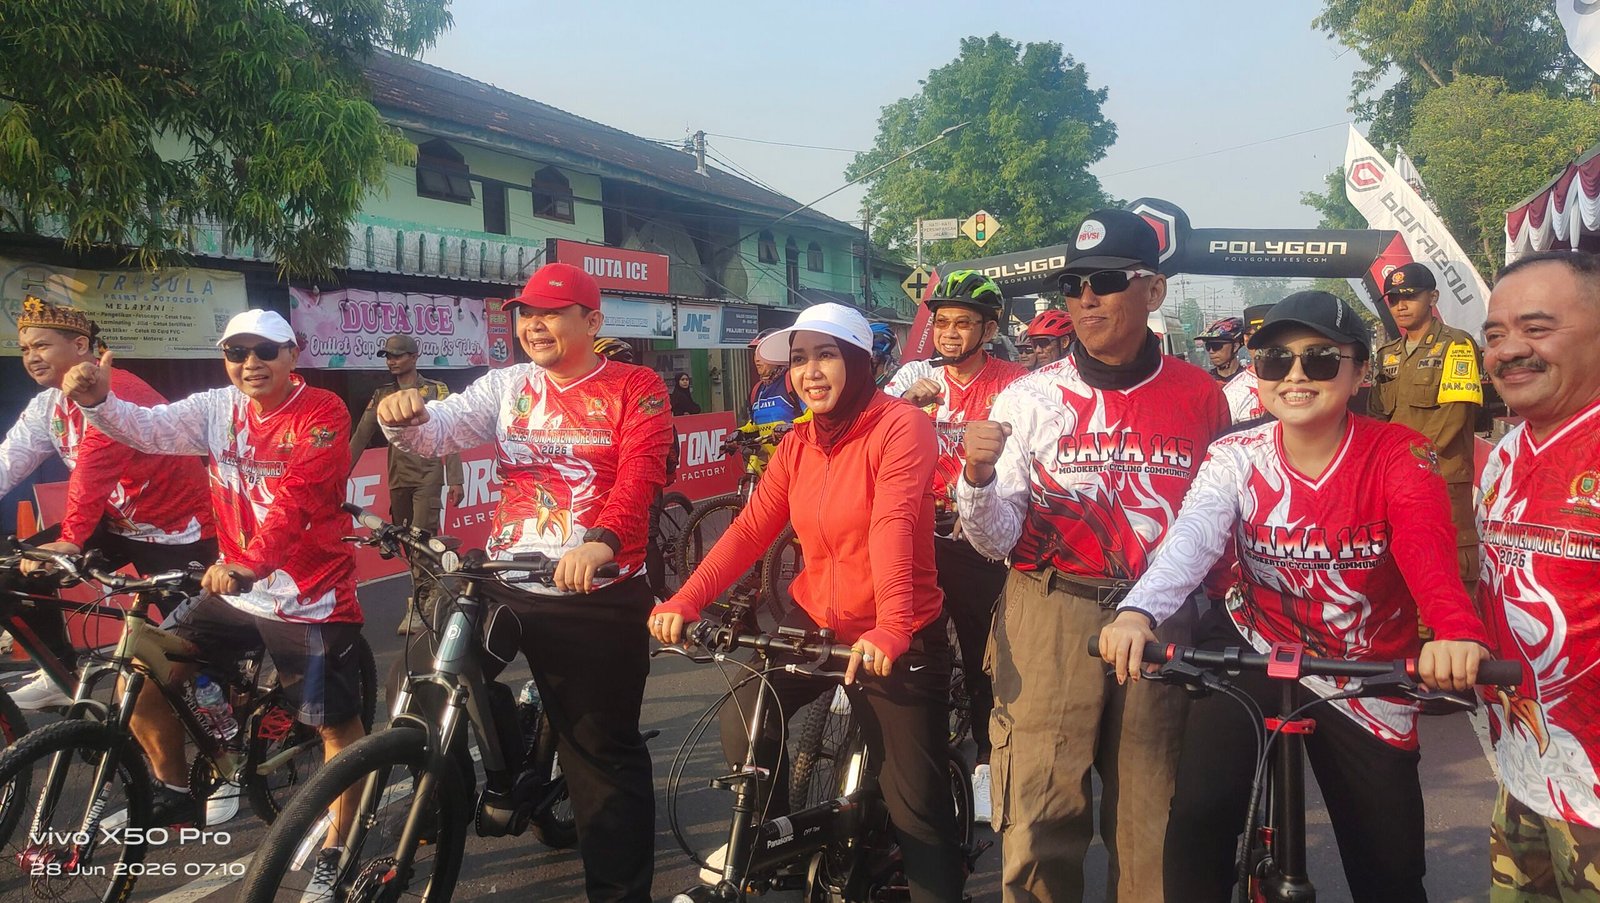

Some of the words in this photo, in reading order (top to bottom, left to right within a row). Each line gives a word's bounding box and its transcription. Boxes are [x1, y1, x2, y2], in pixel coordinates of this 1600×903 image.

[1209, 241, 1348, 255] POLYGON
[583, 256, 623, 278] DUTA
[626, 261, 648, 280] ICE
[978, 255, 1066, 279] OLYGO
[105, 303, 166, 312] MELAYANI
[339, 300, 413, 335] DUTA
[413, 304, 454, 336] ICE
[683, 313, 711, 333] JNE
[310, 335, 350, 357] Outlet
[355, 337, 376, 361] Sop
[442, 338, 456, 357] Es
[541, 445, 567, 455] 2026
[1057, 431, 1145, 464] GAMA
[1150, 434, 1194, 469] 145
[681, 466, 727, 481] FACTORY
[1058, 465, 1107, 475] MOJOKERTO
[1109, 463, 1142, 474] CYCLING
[1144, 466, 1190, 479] COMMUNITY
[1337, 520, 1388, 559] 145
[1289, 560, 1330, 570] CYCLING
[1499, 549, 1527, 568] 2026
[767, 834, 794, 849] Panasonic
